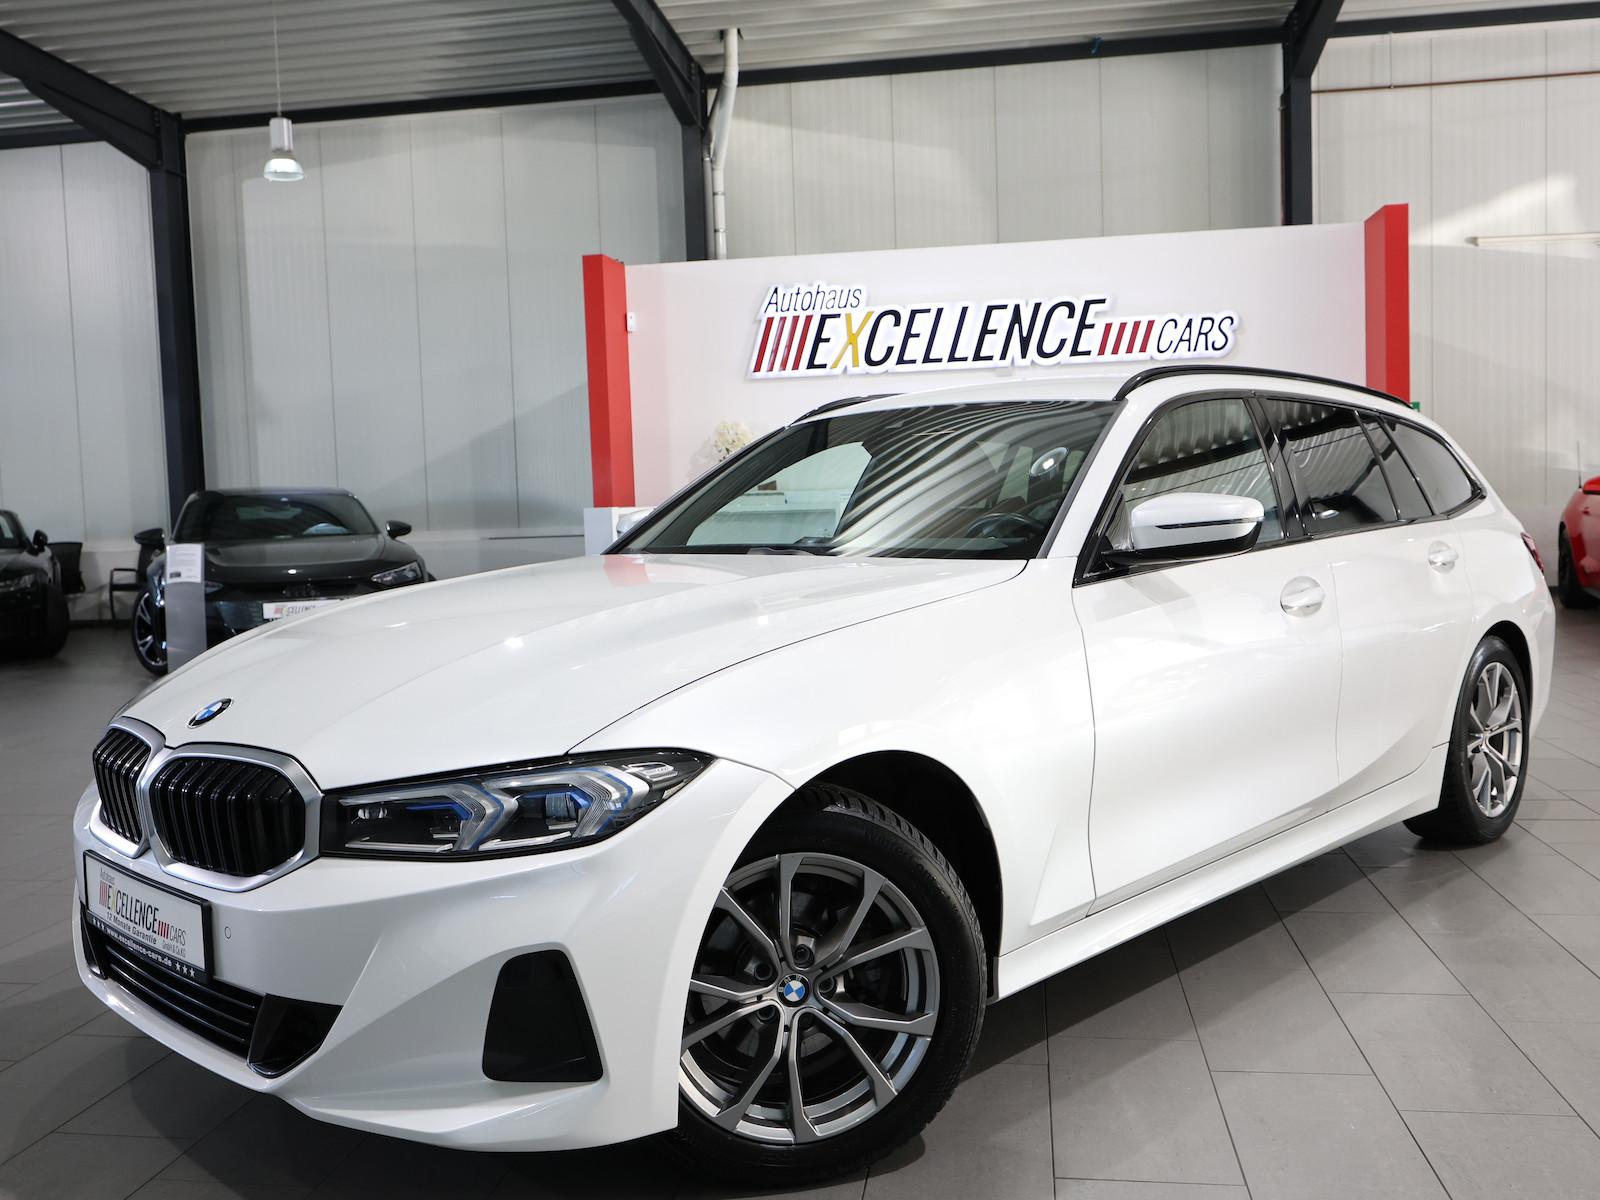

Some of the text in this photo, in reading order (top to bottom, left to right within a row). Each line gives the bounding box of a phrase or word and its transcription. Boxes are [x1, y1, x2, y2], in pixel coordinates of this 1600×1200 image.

[764, 286, 863, 314] Autohaus
[807, 298, 1235, 370] EXCELLENCE CARS
[107, 885, 187, 947] EXCELLENCE CARS
[113, 915, 131, 933] Monate
[132, 926, 157, 945] Garantie
